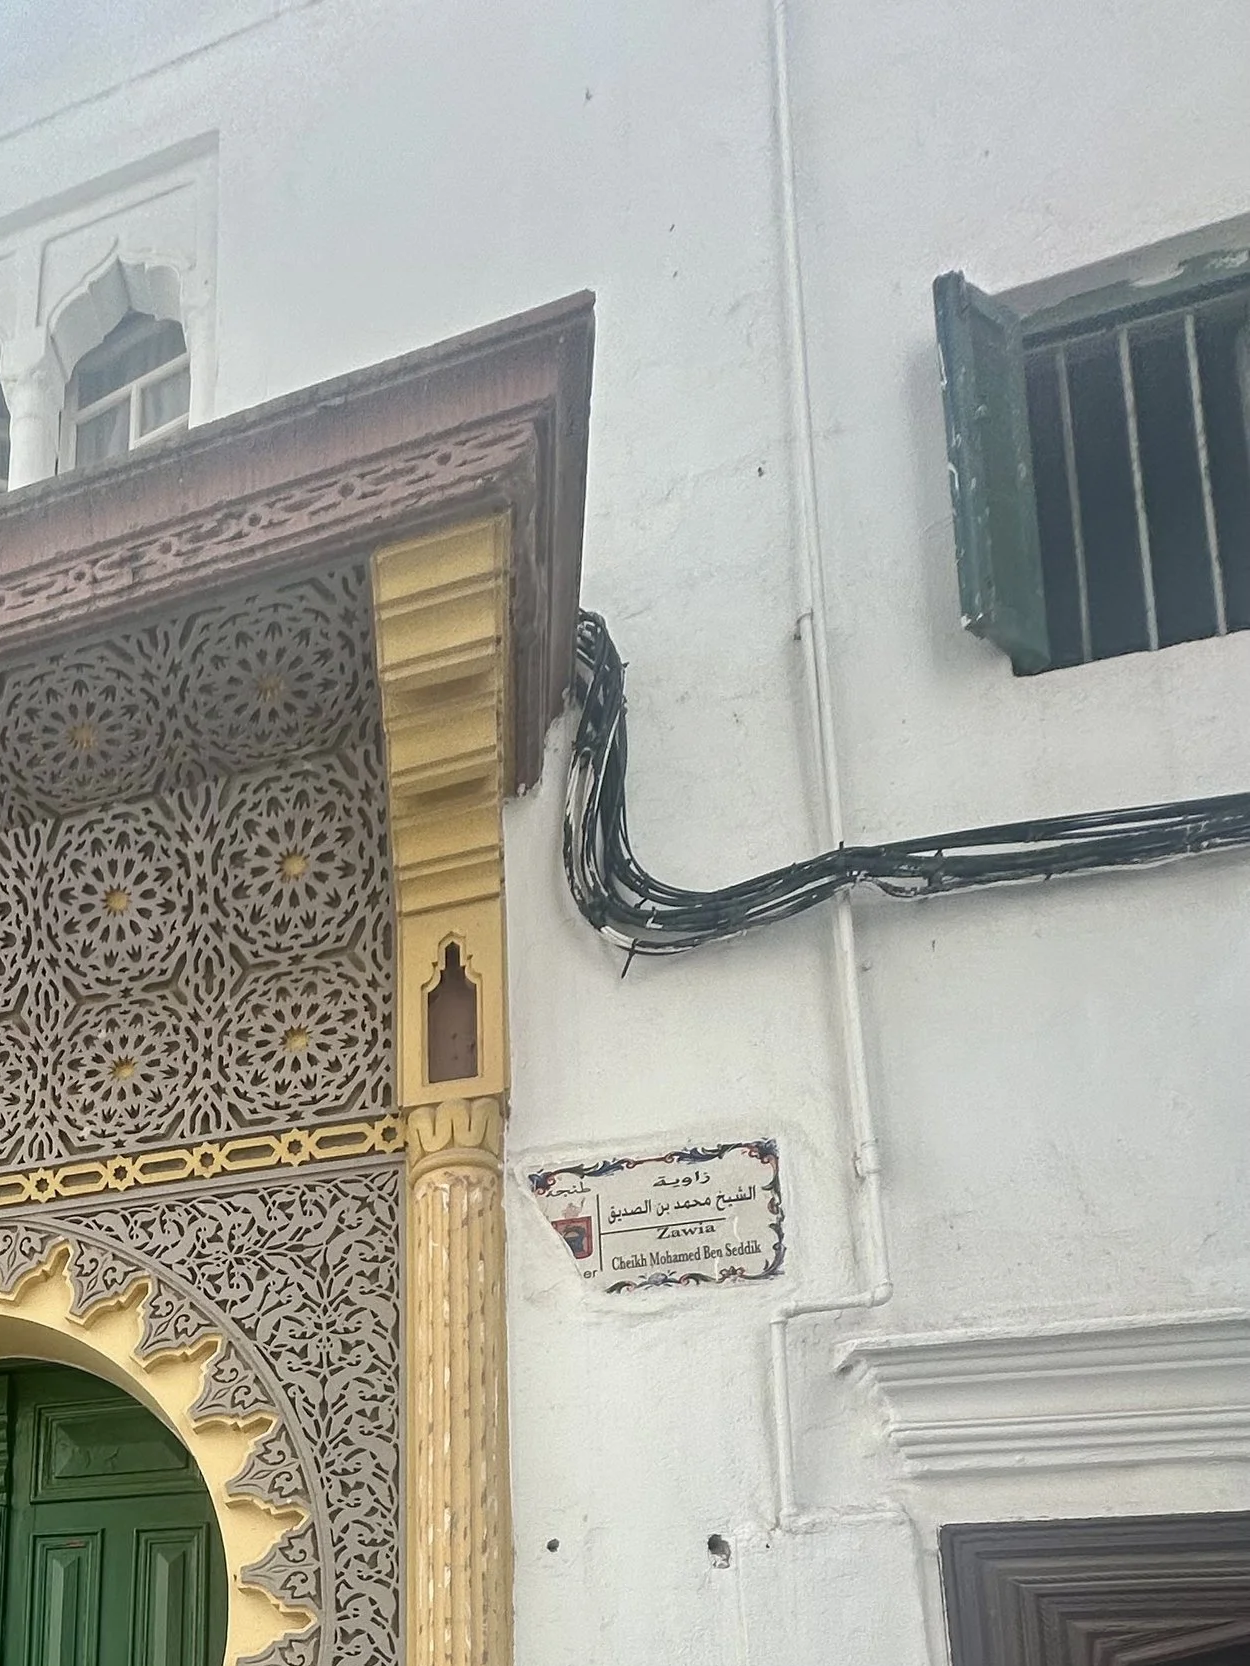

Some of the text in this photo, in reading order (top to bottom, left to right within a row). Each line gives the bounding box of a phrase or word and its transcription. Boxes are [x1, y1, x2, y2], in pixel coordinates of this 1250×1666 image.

[652, 1170, 711, 1188] زاوية
[607, 1185, 757, 1224] الشيخ محمد بن الصديق
[656, 1222, 716, 1240] Zawia
[649, 1249, 701, 1268] Mohamed
[702, 1245, 723, 1260] Ben
